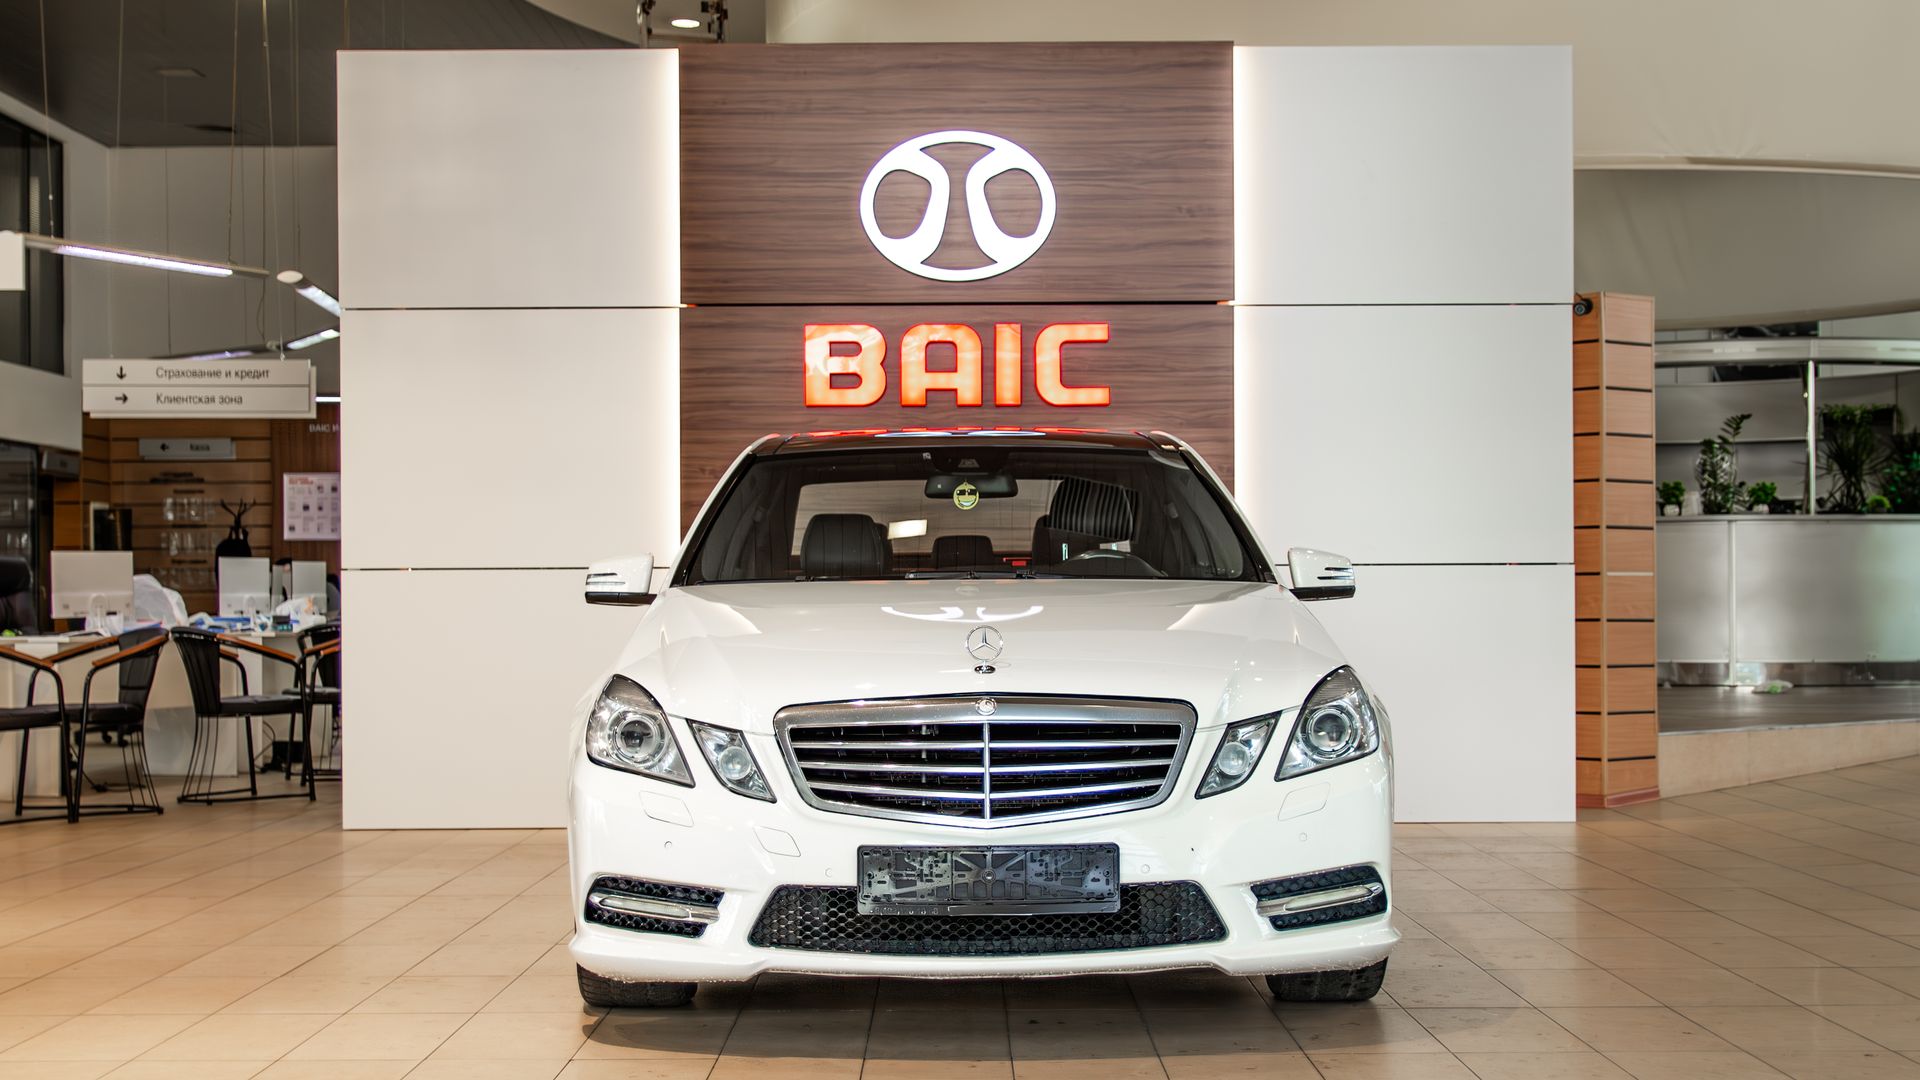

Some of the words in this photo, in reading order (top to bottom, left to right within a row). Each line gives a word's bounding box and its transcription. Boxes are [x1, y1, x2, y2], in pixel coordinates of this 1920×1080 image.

[804, 322, 1110, 407] BAIC
[155, 366, 222, 381] Страхование
[225, 369, 232, 378] и
[234, 368, 270, 380] кредит
[156, 392, 217, 405] Клиентская
[218, 395, 243, 405] зона
